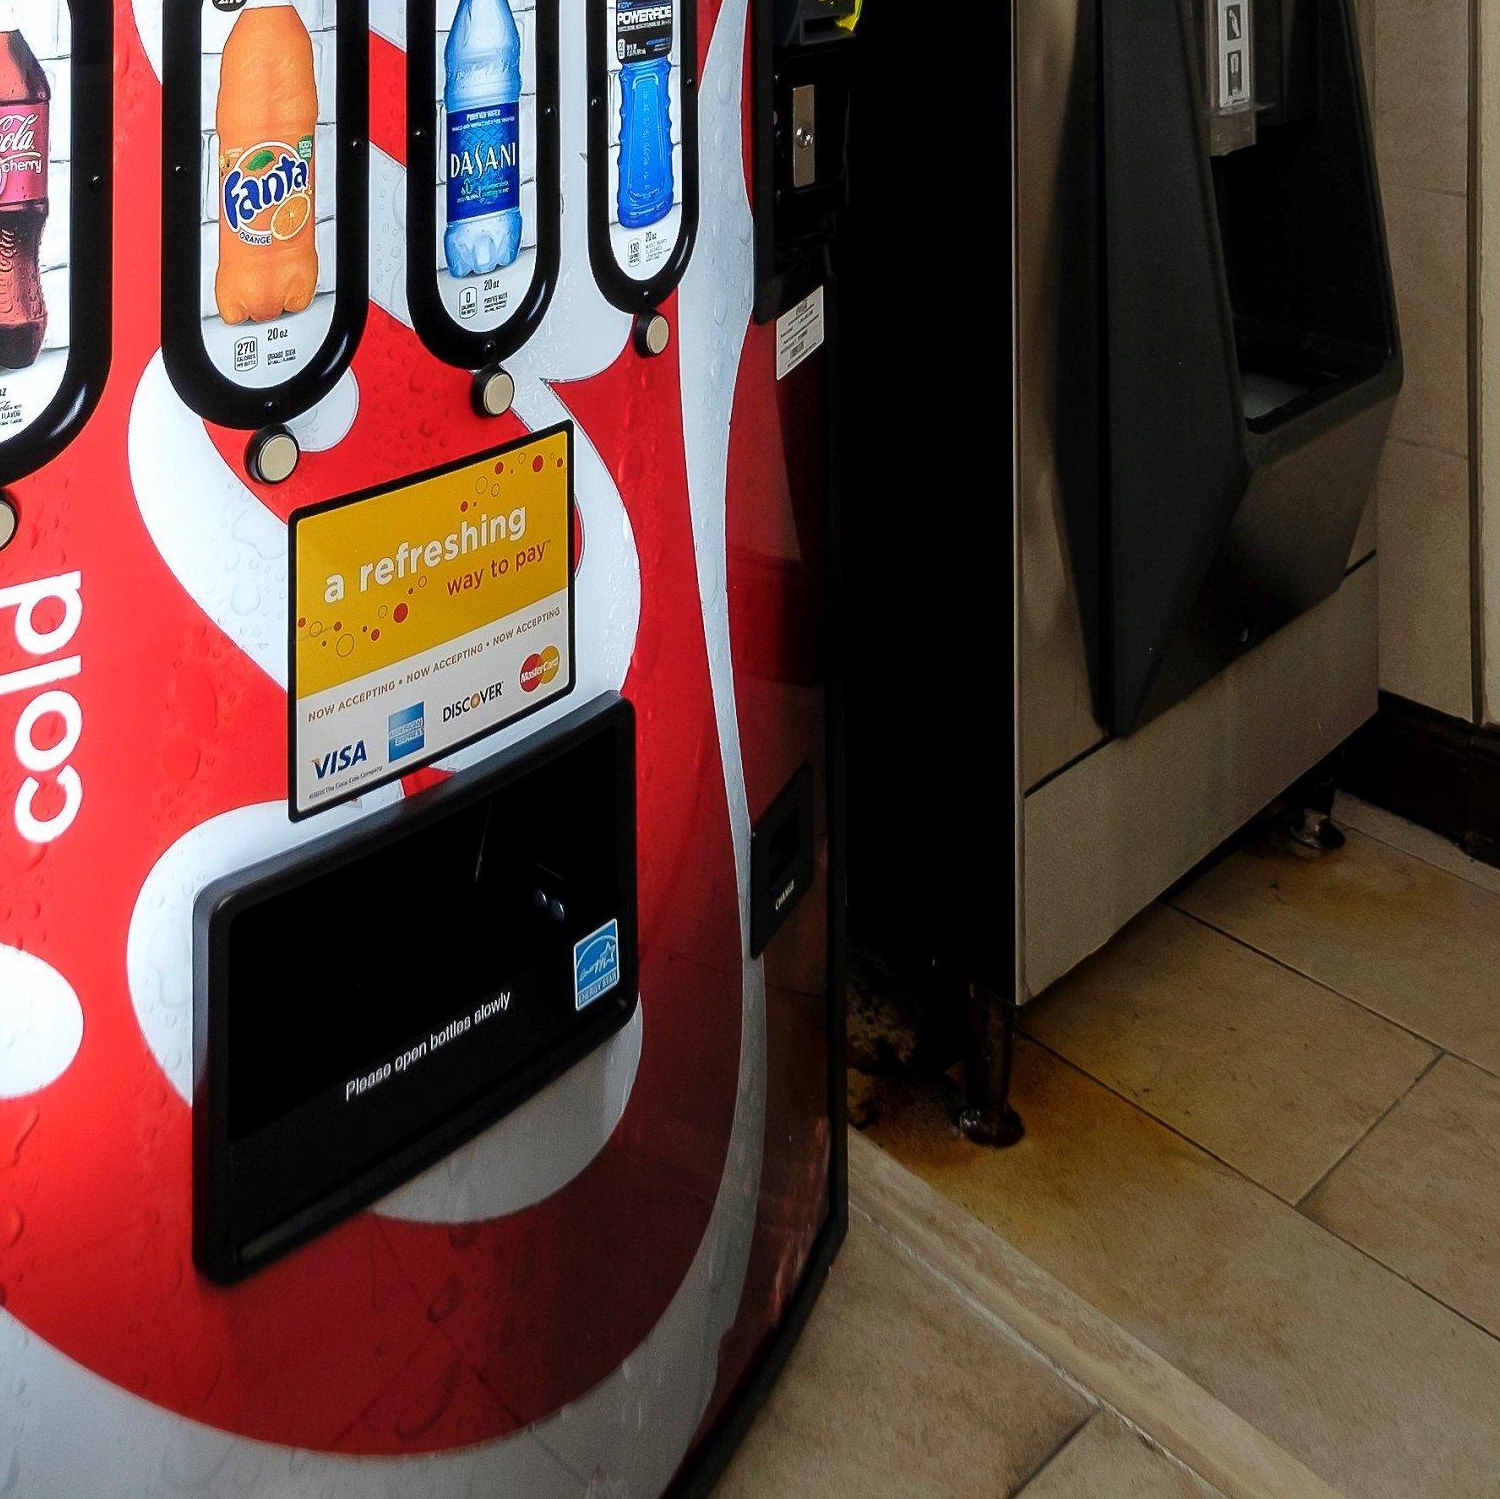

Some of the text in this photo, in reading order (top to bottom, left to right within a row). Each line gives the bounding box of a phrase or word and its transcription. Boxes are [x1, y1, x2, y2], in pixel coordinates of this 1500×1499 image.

[616, 5, 672, 26] POWERADE
[2, 160, 43, 174] cherry
[450, 142, 516, 180] DASANI
[224, 156, 308, 230] Fanta
[239, 231, 271, 245] ORANGE
[237, 340, 256, 357] 270
[267, 327, 288, 342] 20 oz
[324, 505, 527, 603] a refreshing
[447, 541, 548, 596] way to pay
[307, 606, 561, 723] NOW ACCEPTING NOW ACCEPTING NOW ACCEPTING
[520, 655, 560, 684] MasterCard
[442, 682, 503, 723] DISCOVER
[311, 739, 368, 780] VISA
[346, 991, 511, 1102] Please open bottles slowly
